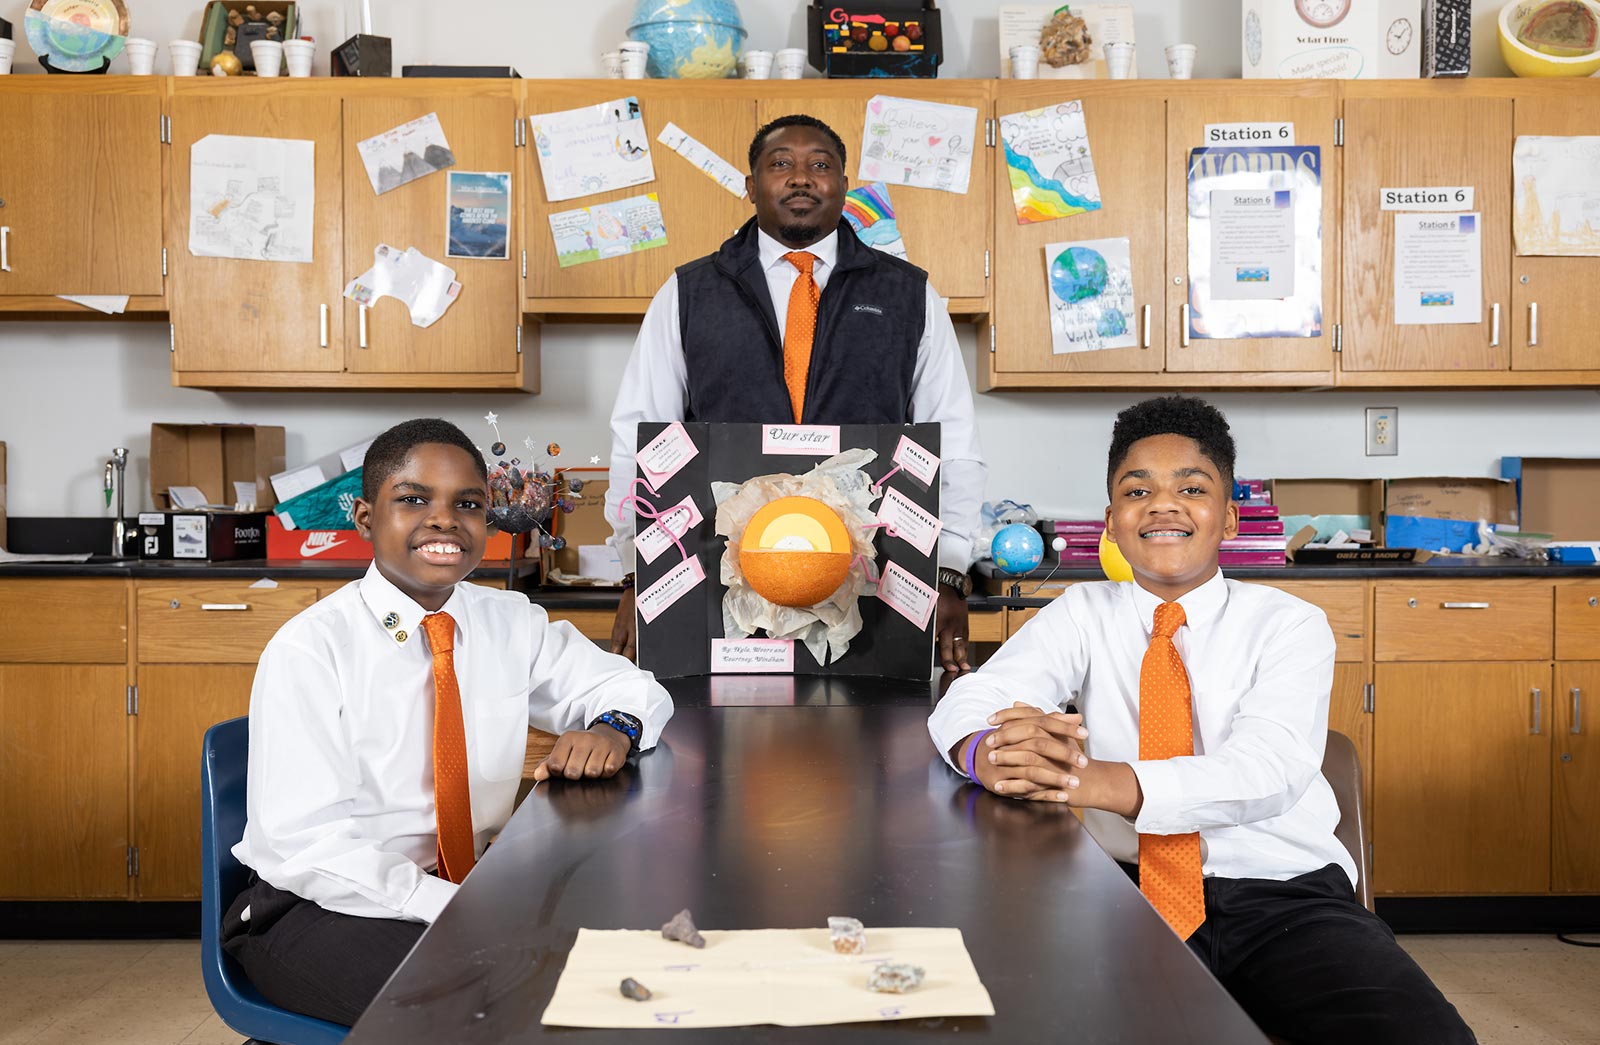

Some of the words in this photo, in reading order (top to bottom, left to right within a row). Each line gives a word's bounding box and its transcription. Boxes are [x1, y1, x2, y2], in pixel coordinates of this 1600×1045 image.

[1291, 63, 1314, 76] Made
[889, 109, 937, 130] Believe
[1210, 127, 1272, 141] Station
[1279, 126, 1289, 139] 6
[1233, 196, 1264, 205] Station
[1265, 196, 1271, 204] 6
[1386, 190, 1448, 204] Station
[1455, 189, 1465, 202] 6
[1418, 221, 1449, 229] Station
[1450, 220, 1456, 229] 6
[860, 305, 882, 314] Columbia
[1065, 329, 1094, 343] World
[769, 427, 798, 441] Our
[800, 431, 831, 444] star
[144, 536, 159, 555] FJ
[307, 532, 337, 547] NIKE
